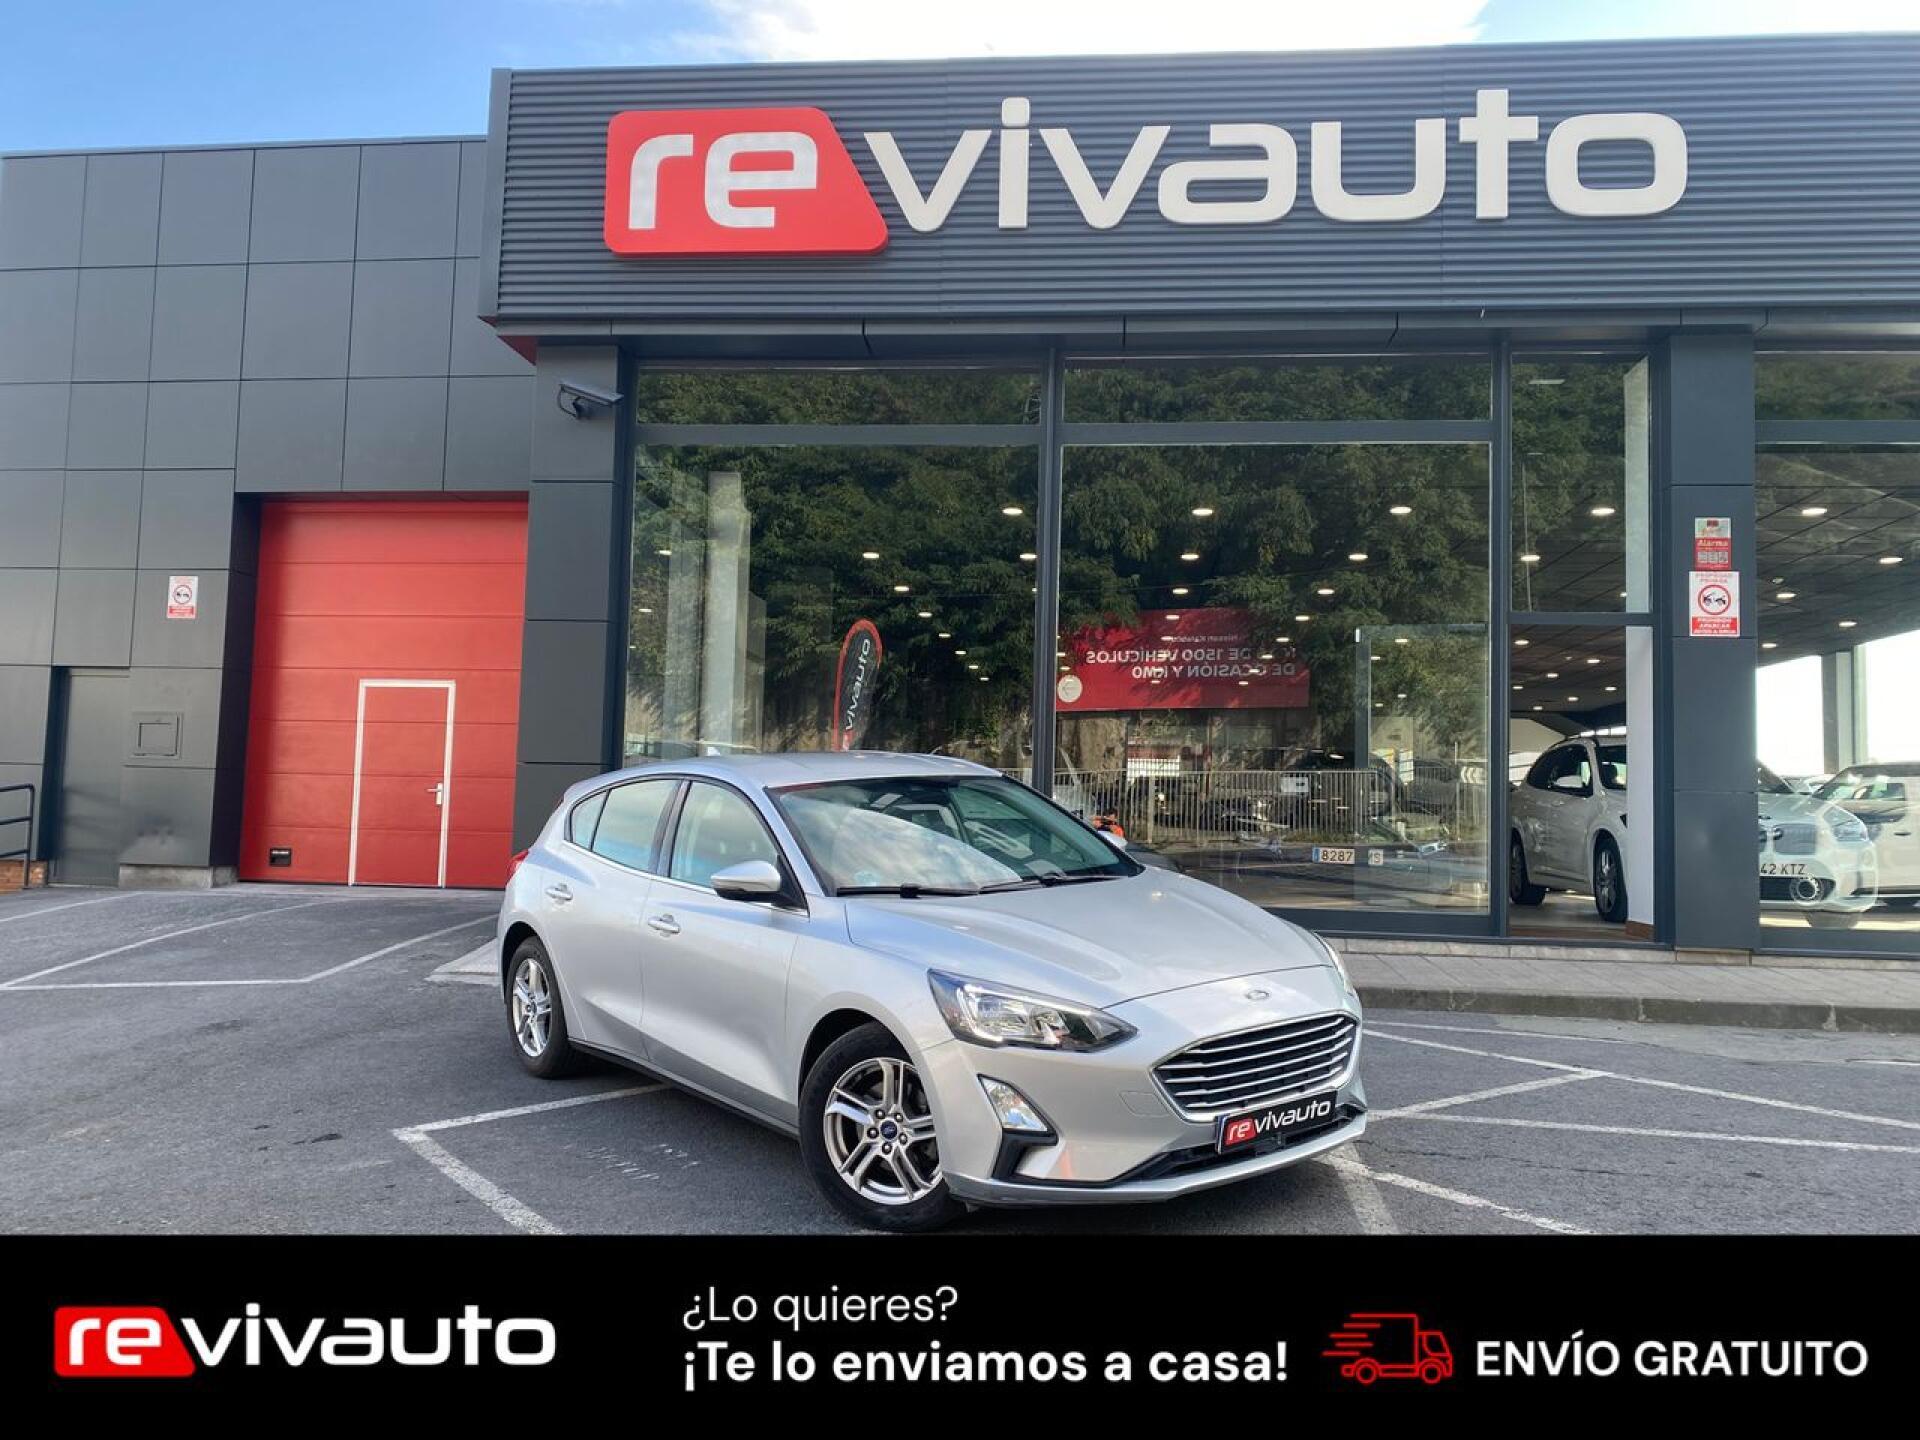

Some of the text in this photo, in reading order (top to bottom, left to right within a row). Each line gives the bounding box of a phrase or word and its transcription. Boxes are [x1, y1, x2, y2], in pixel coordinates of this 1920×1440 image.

[628, 89, 1688, 233] revivauto
[842, 638, 870, 751] vivauto
[1321, 849, 1354, 862] 8287
[1780, 863, 1808, 875] KTZ
[1229, 1100, 1331, 1141] revivauto
